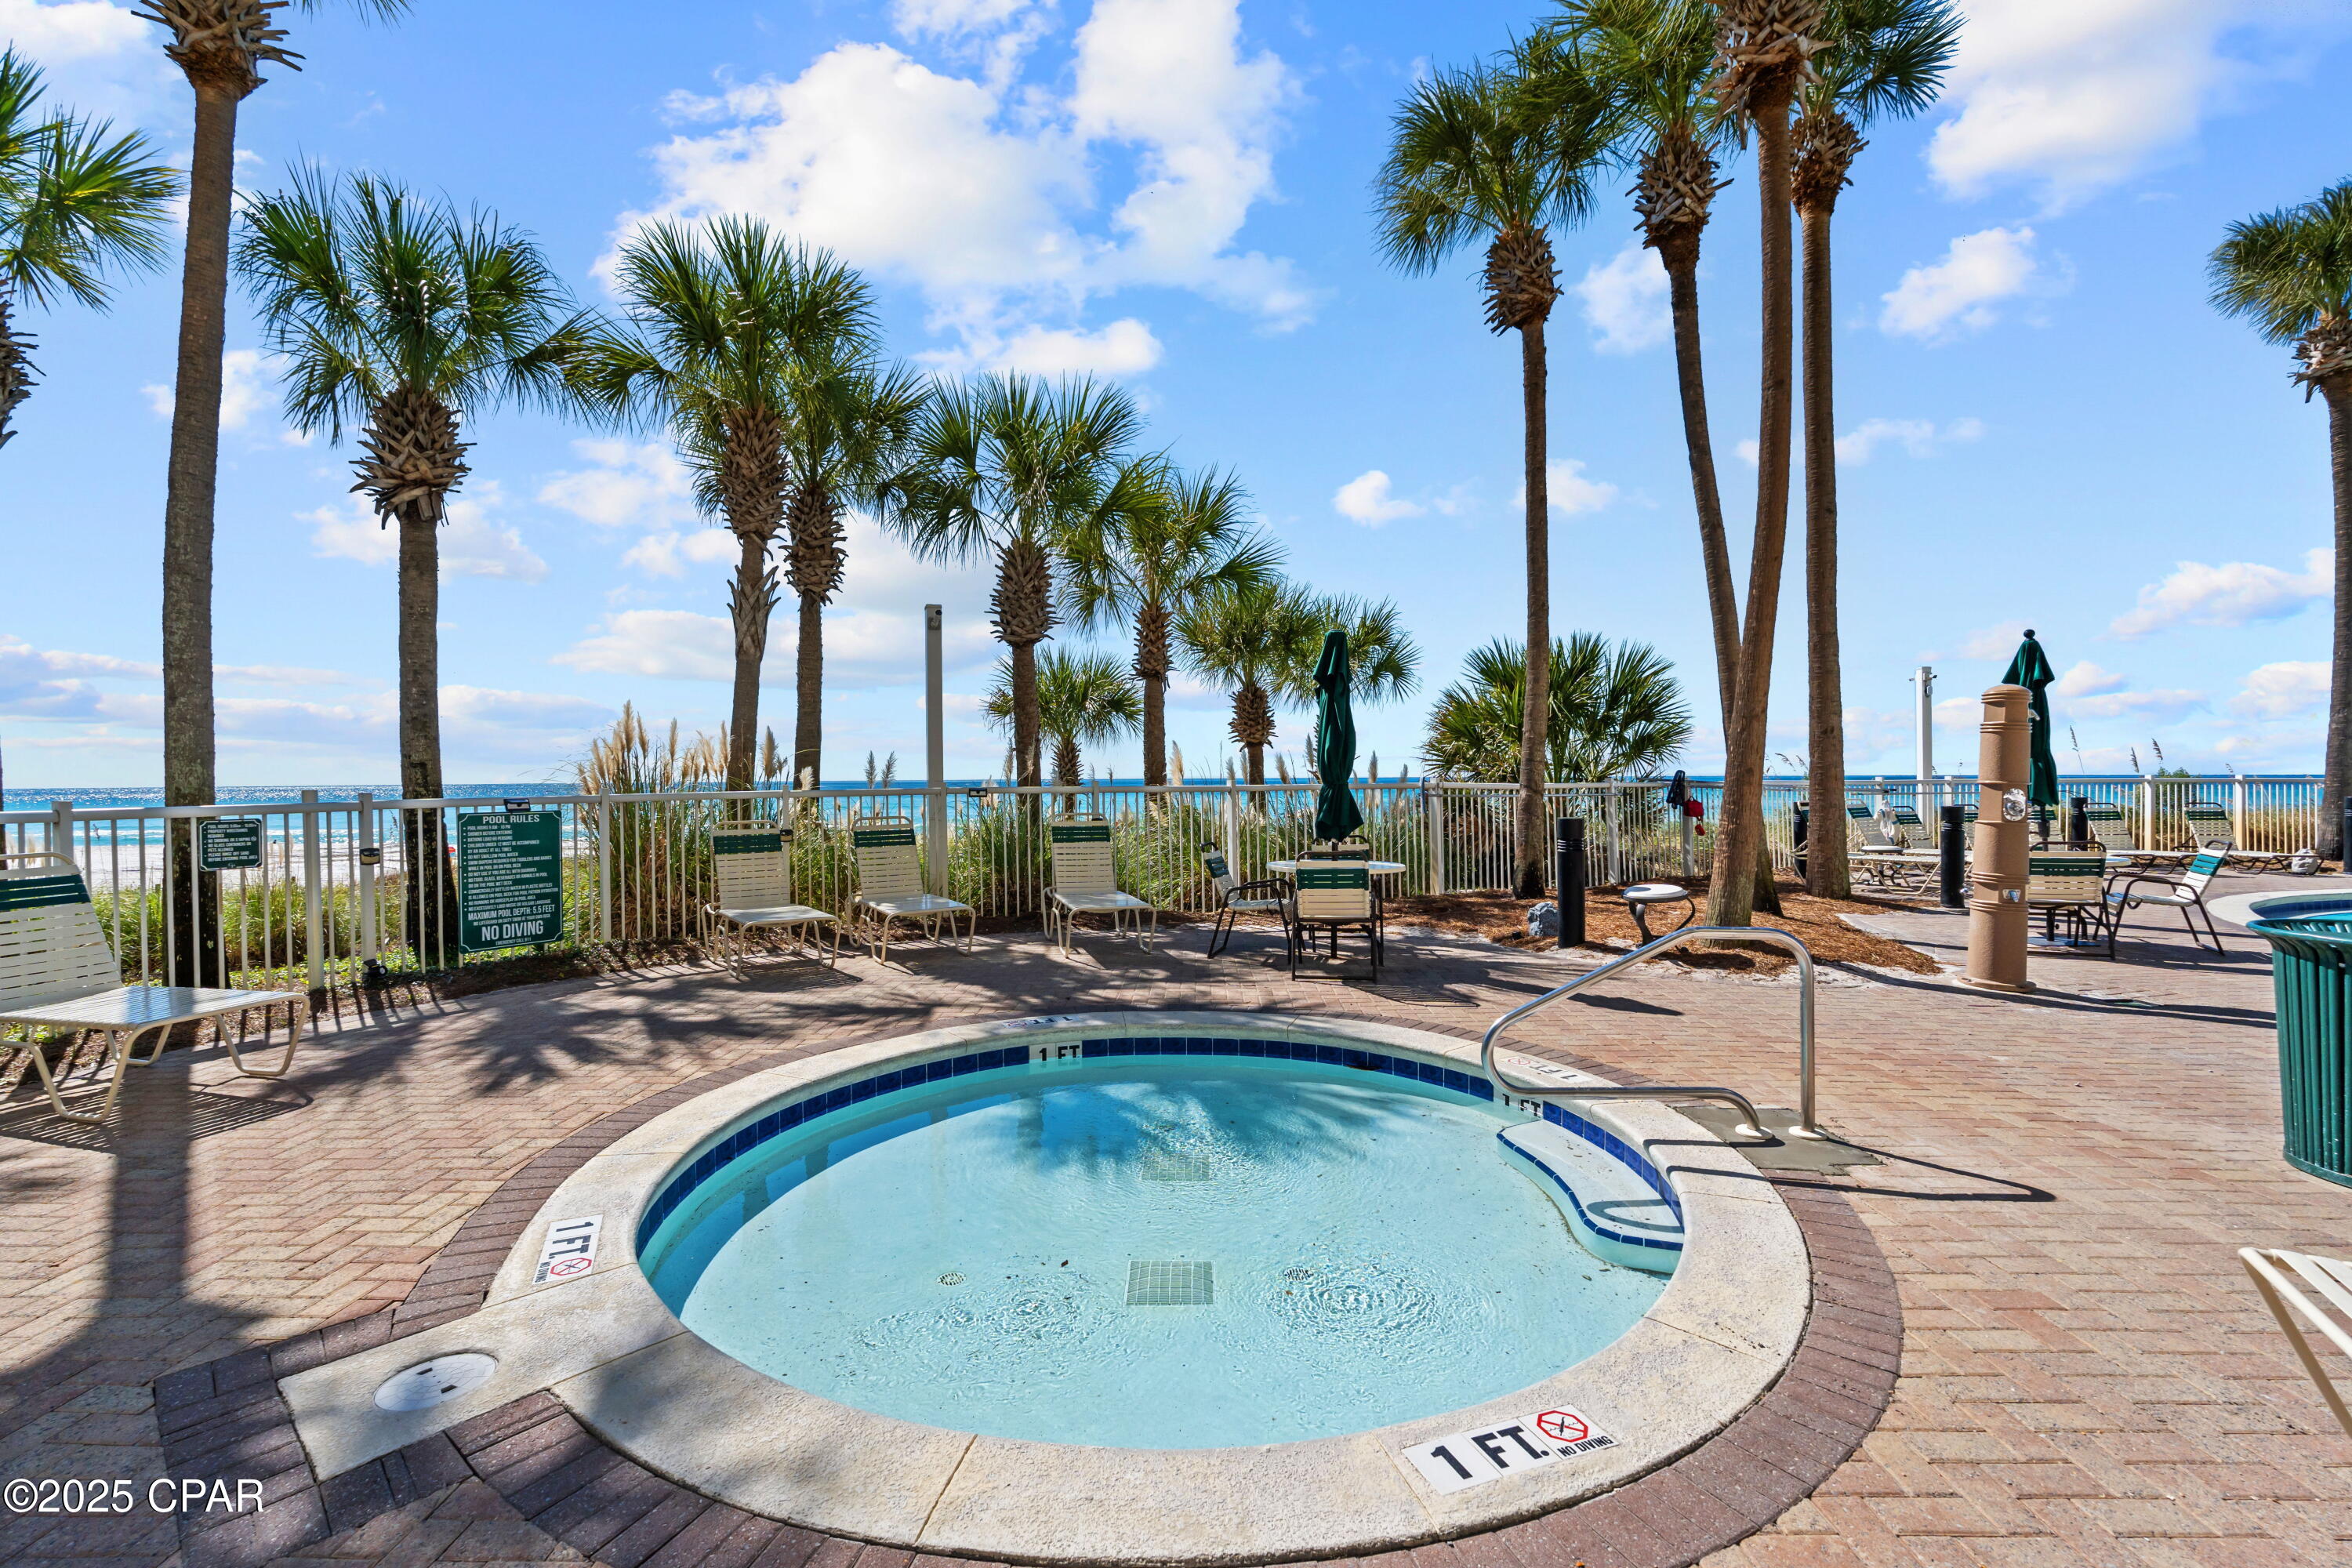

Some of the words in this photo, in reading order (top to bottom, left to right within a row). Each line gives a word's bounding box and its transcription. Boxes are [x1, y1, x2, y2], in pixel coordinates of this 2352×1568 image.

[483, 816, 507, 824] POOL
[510, 815, 540, 823] RULES
[468, 910, 496, 921] MAXIMUM
[498, 909, 512, 917] POOL
[513, 907, 532, 916] DEPTH:
[543, 905, 555, 913] FEET
[482, 925, 499, 941] NO
[503, 920, 543, 939] DIVING
[1039, 1048, 1047, 1061] 1
[556, 1221, 594, 1232] 1
[549, 1235, 591, 1259] FT.
[1431, 1445, 1473, 1479] 1
[1471, 1425, 1550, 1469] FT.
[1557, 1446, 1577, 1457] NO
[1574, 1436, 1614, 1452] DIVING
